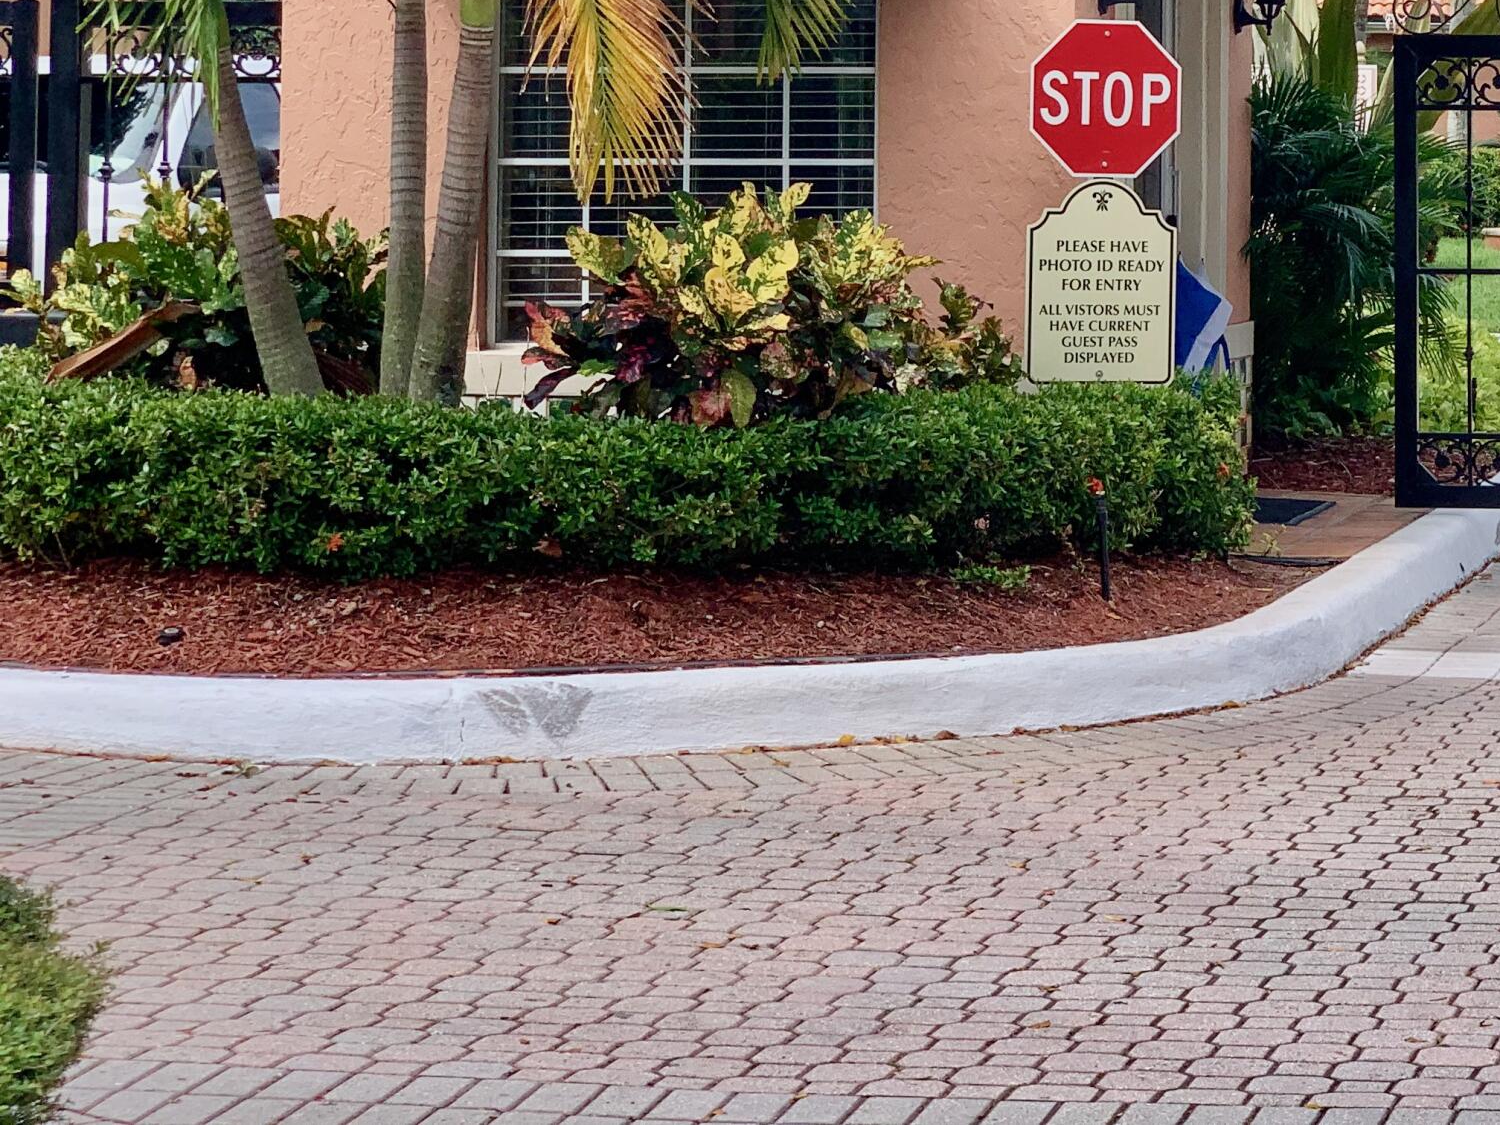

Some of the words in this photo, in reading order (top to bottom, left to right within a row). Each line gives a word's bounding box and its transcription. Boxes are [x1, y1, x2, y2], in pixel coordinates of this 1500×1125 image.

[1040, 69, 1172, 127] STOP
[1056, 240, 1106, 253] PLEASE
[1110, 240, 1149, 253] HAVE
[1039, 258, 1092, 272] PHOTO
[1097, 259, 1113, 272] ID
[1118, 259, 1165, 273] READY
[1061, 278, 1091, 291] FOR
[1096, 279, 1142, 291] ENTRY
[1039, 304, 1062, 315] ALL
[1065, 304, 1120, 316] VISTORS
[1123, 304, 1161, 316] MUST
[1049, 320, 1085, 331] HAVE
[1088, 320, 1151, 332] CURRENT
[1061, 335, 1105, 347] GUEST
[1108, 336, 1138, 348] PASS
[1064, 352, 1134, 363] DISPLAYED
